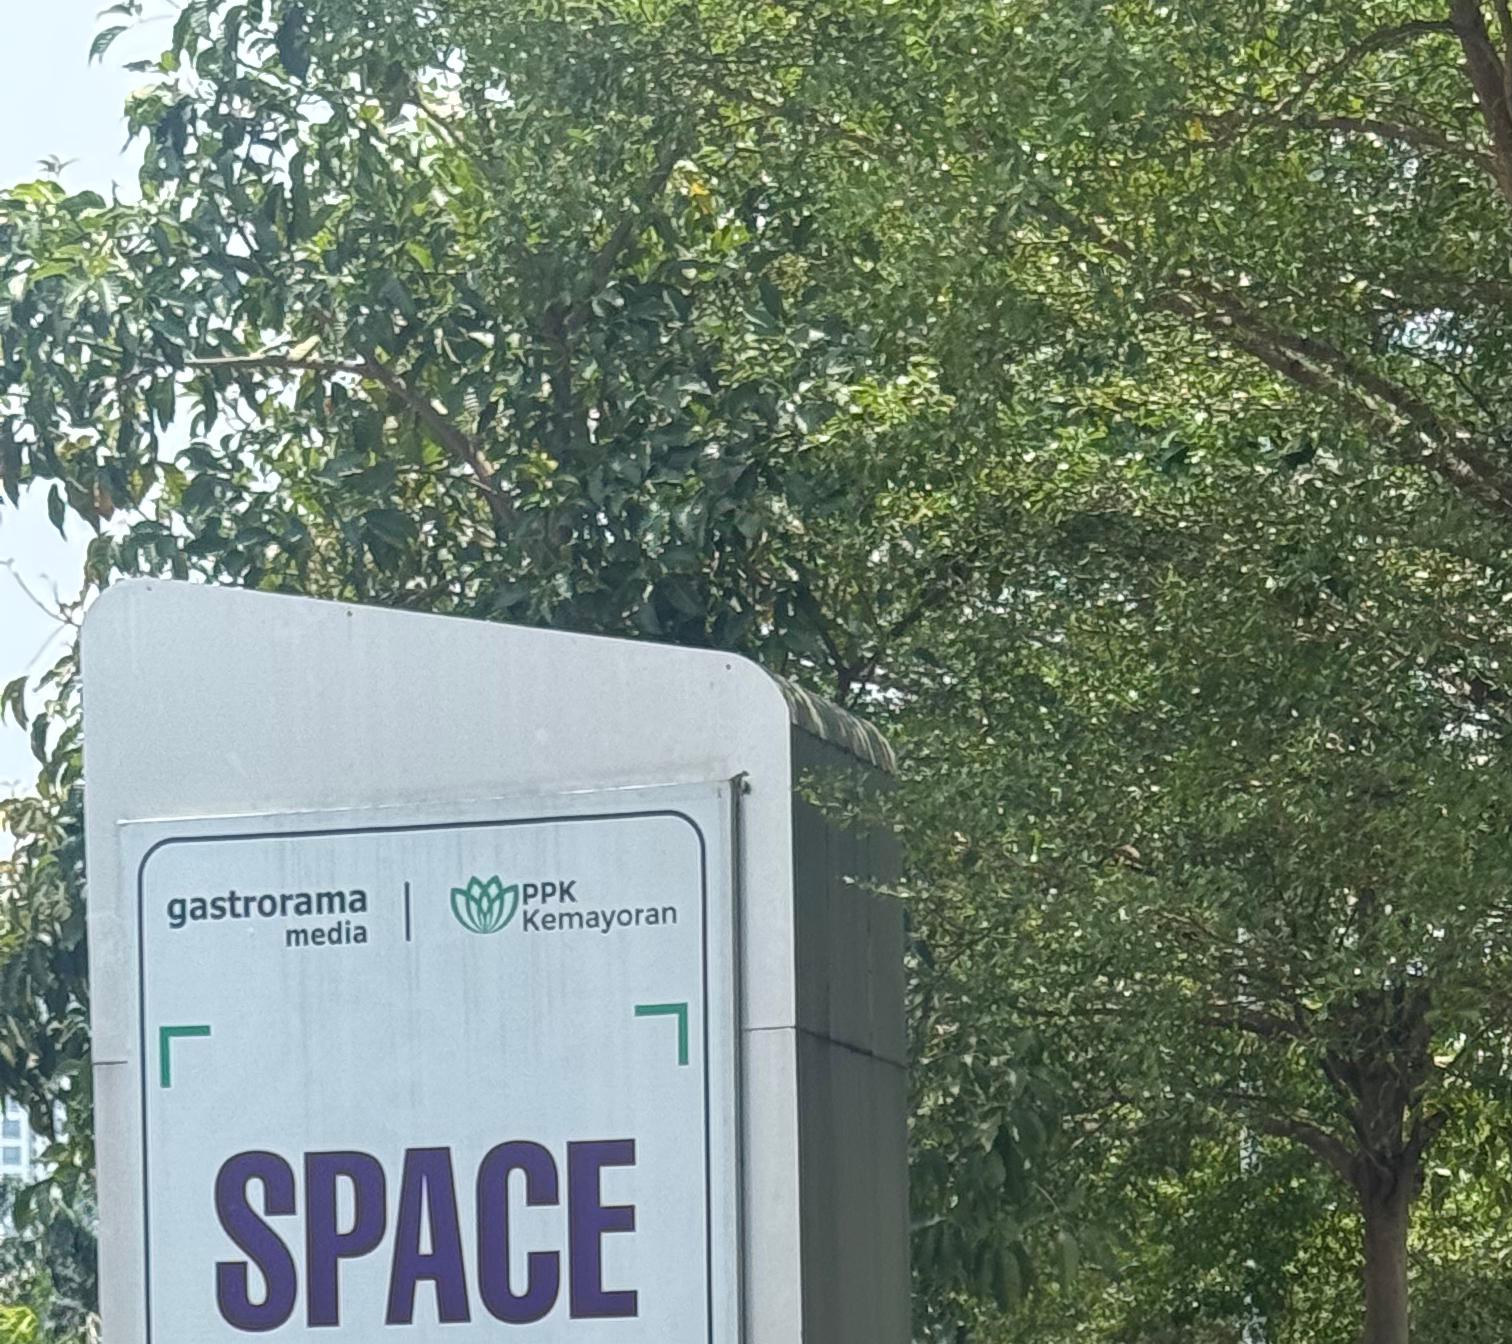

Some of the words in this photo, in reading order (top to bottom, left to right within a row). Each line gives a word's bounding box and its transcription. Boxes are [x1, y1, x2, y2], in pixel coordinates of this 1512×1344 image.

[166, 885, 368, 929] gastrorama
[521, 880, 578, 905] PPK
[284, 919, 368, 947] media
[521, 902, 678, 934] Kemayoran
[214, 1138, 639, 1332] SPACE
